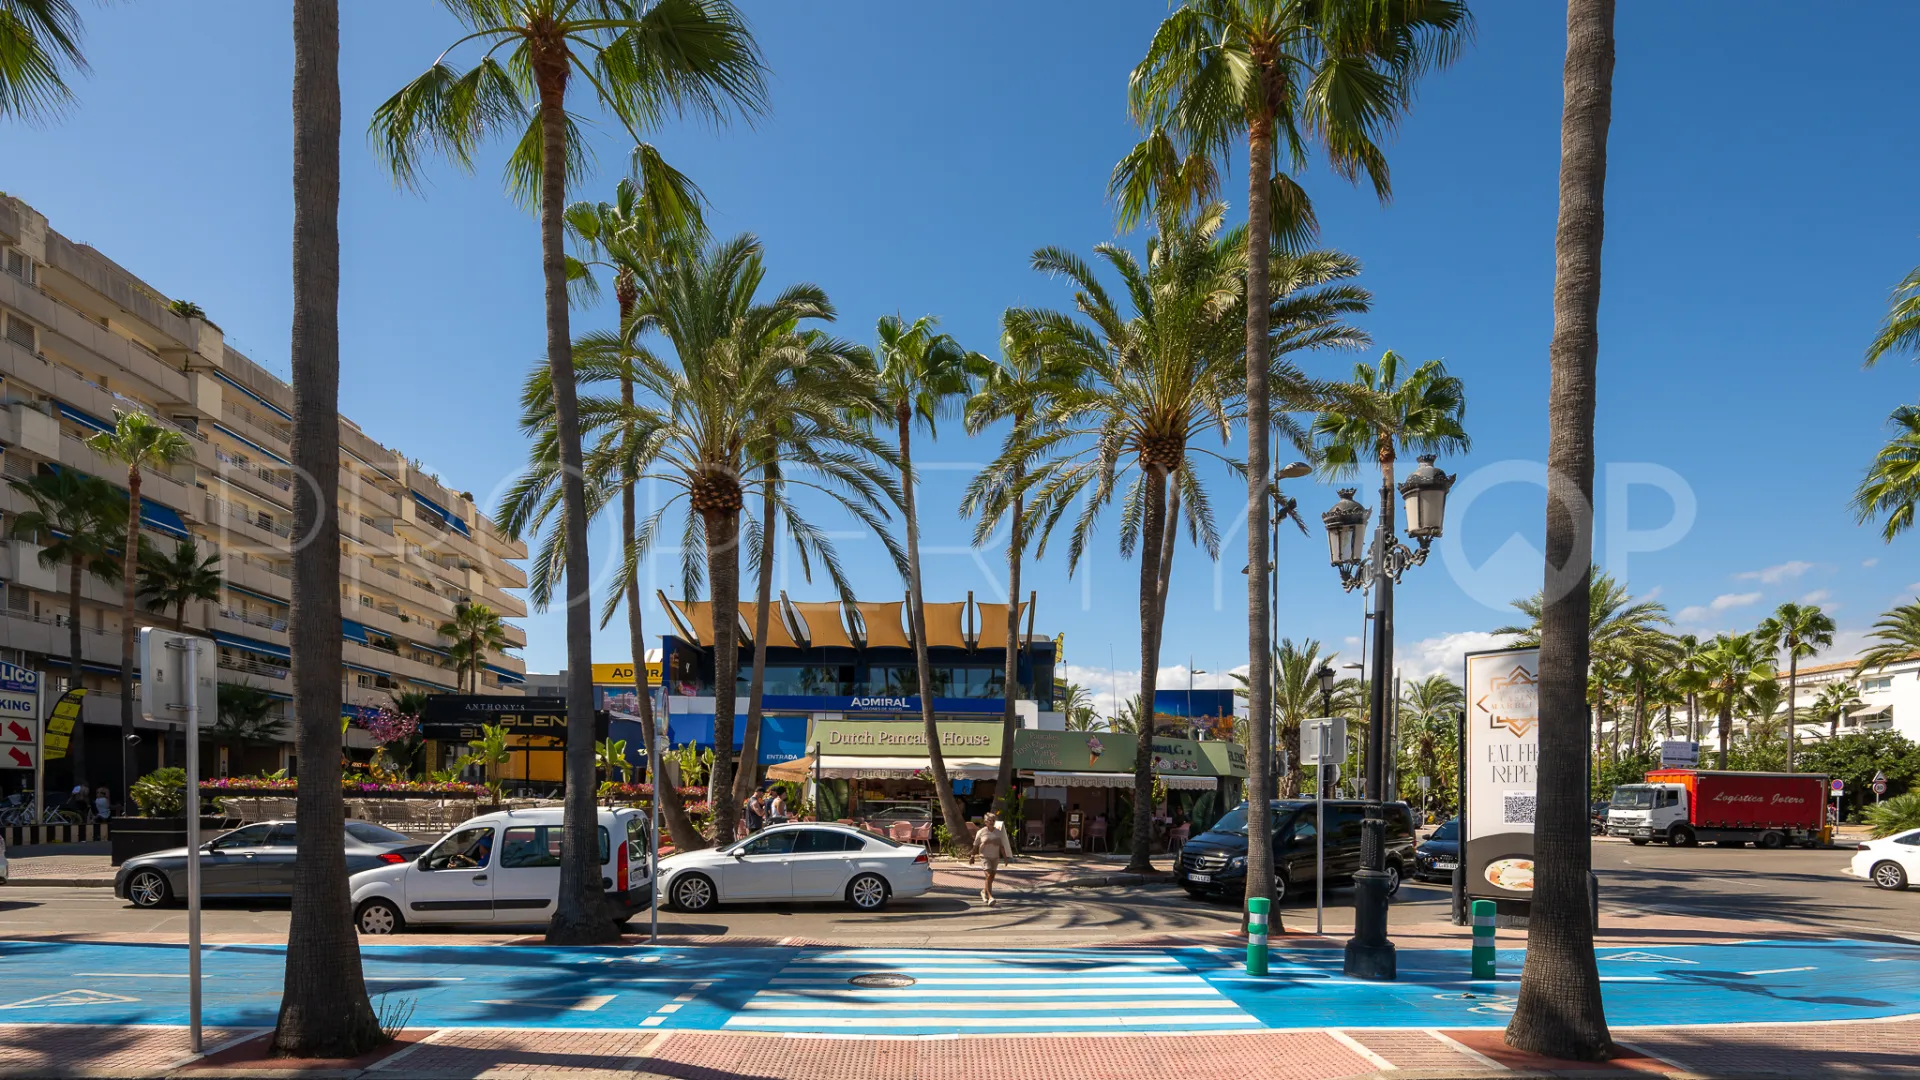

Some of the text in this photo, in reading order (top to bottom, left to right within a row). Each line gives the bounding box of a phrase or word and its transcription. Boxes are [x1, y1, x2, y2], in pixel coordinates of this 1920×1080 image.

[0, 664, 35, 684] LICO
[465, 703, 525, 711] ANTHONY'S
[851, 697, 910, 708] ADMIRAL
[500, 714, 567, 727] BLEN
[829, 731, 991, 747] Dutch Pancak House
[1040, 775, 1068, 785] Dutch
[1070, 776, 1105, 786] Pancake
[1492, 765, 1538, 783] REPE
[1712, 791, 1764, 804] Logistica
